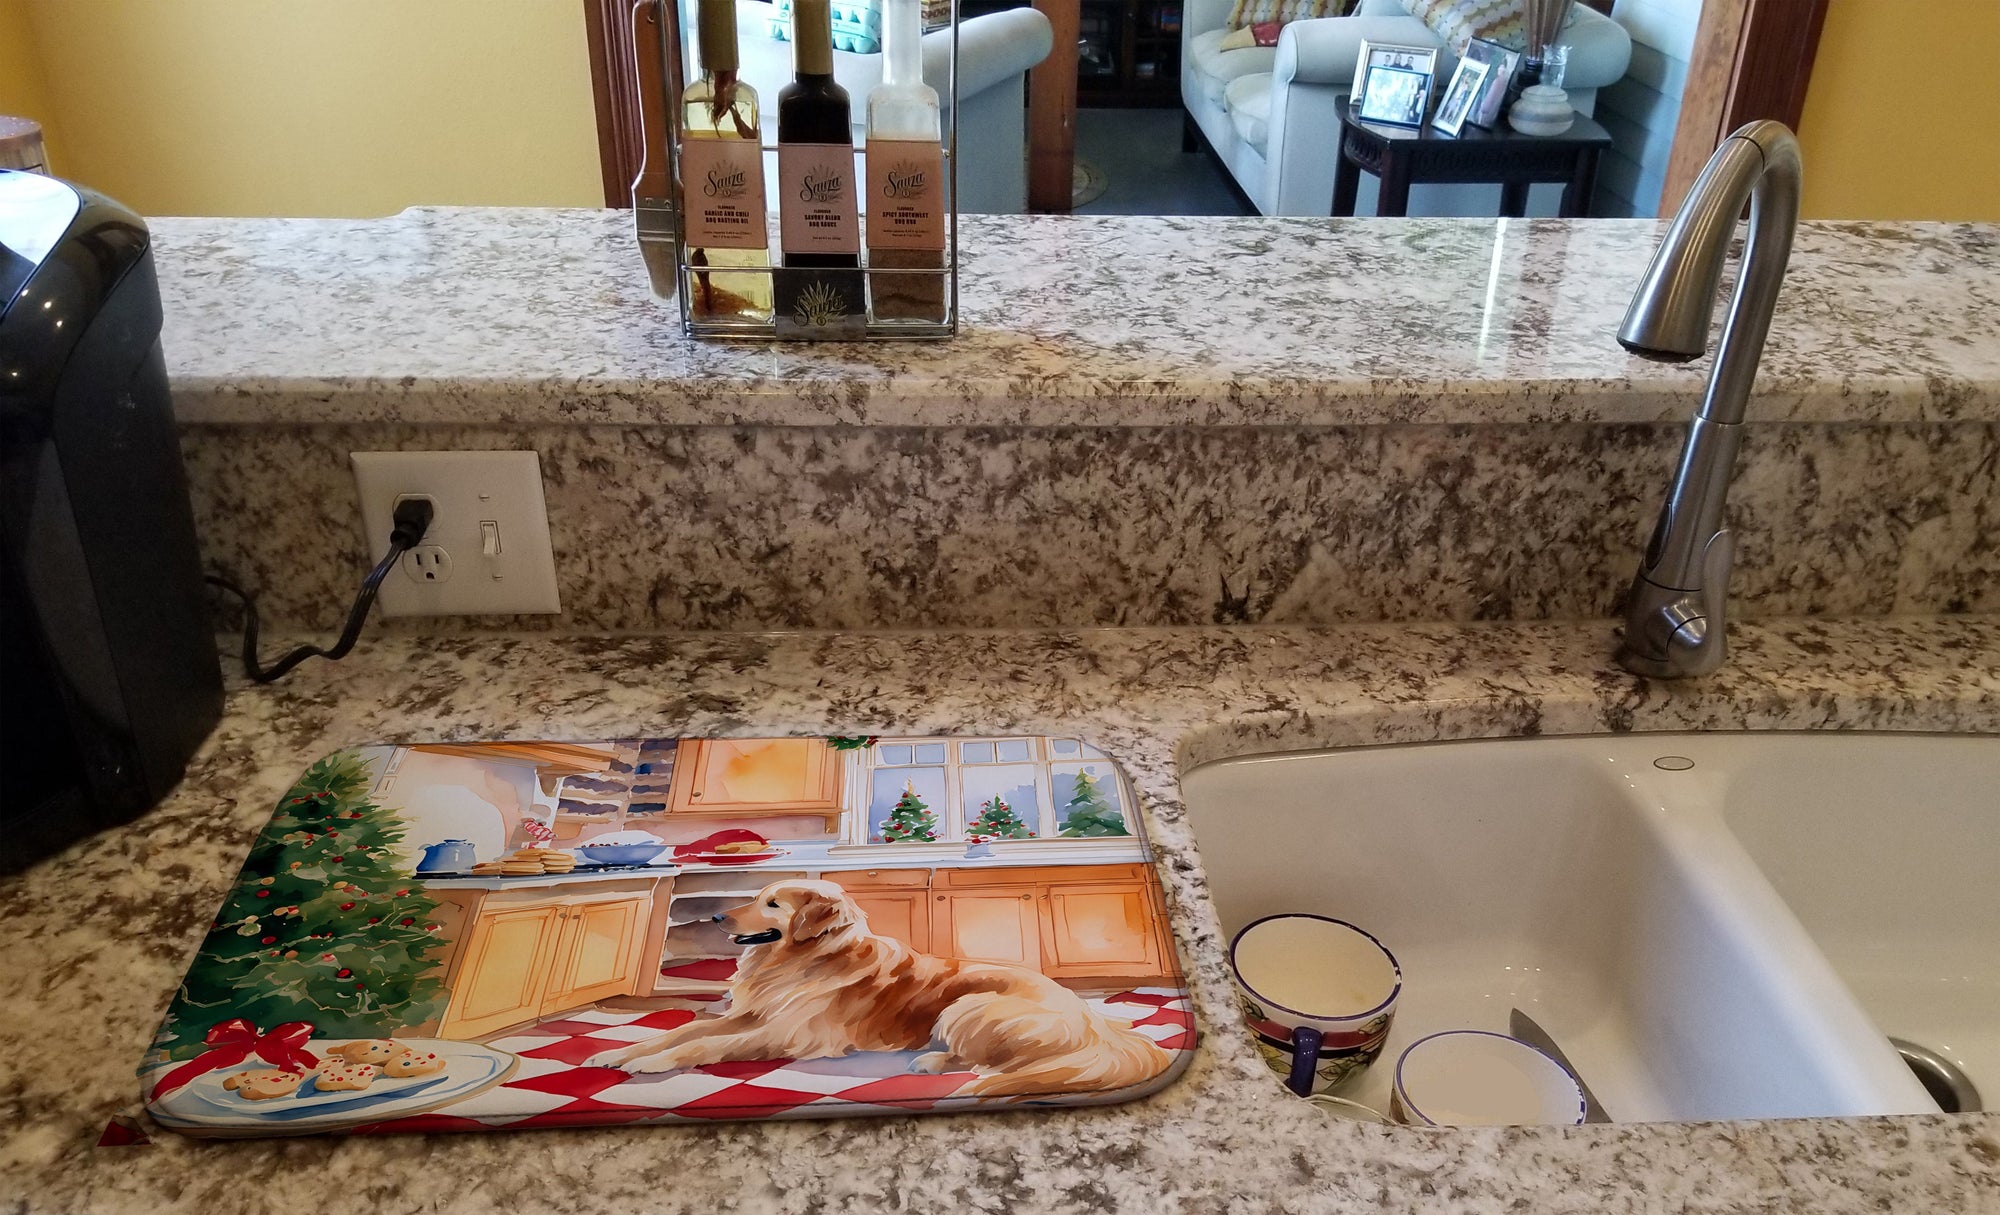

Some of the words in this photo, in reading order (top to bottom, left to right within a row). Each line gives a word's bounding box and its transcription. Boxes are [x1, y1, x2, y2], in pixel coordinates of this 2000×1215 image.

[704, 170, 745, 197] Sauza
[800, 175, 841, 202] Sauza
[884, 170, 925, 198] Sauza
[793, 294, 844, 327] Sauza
